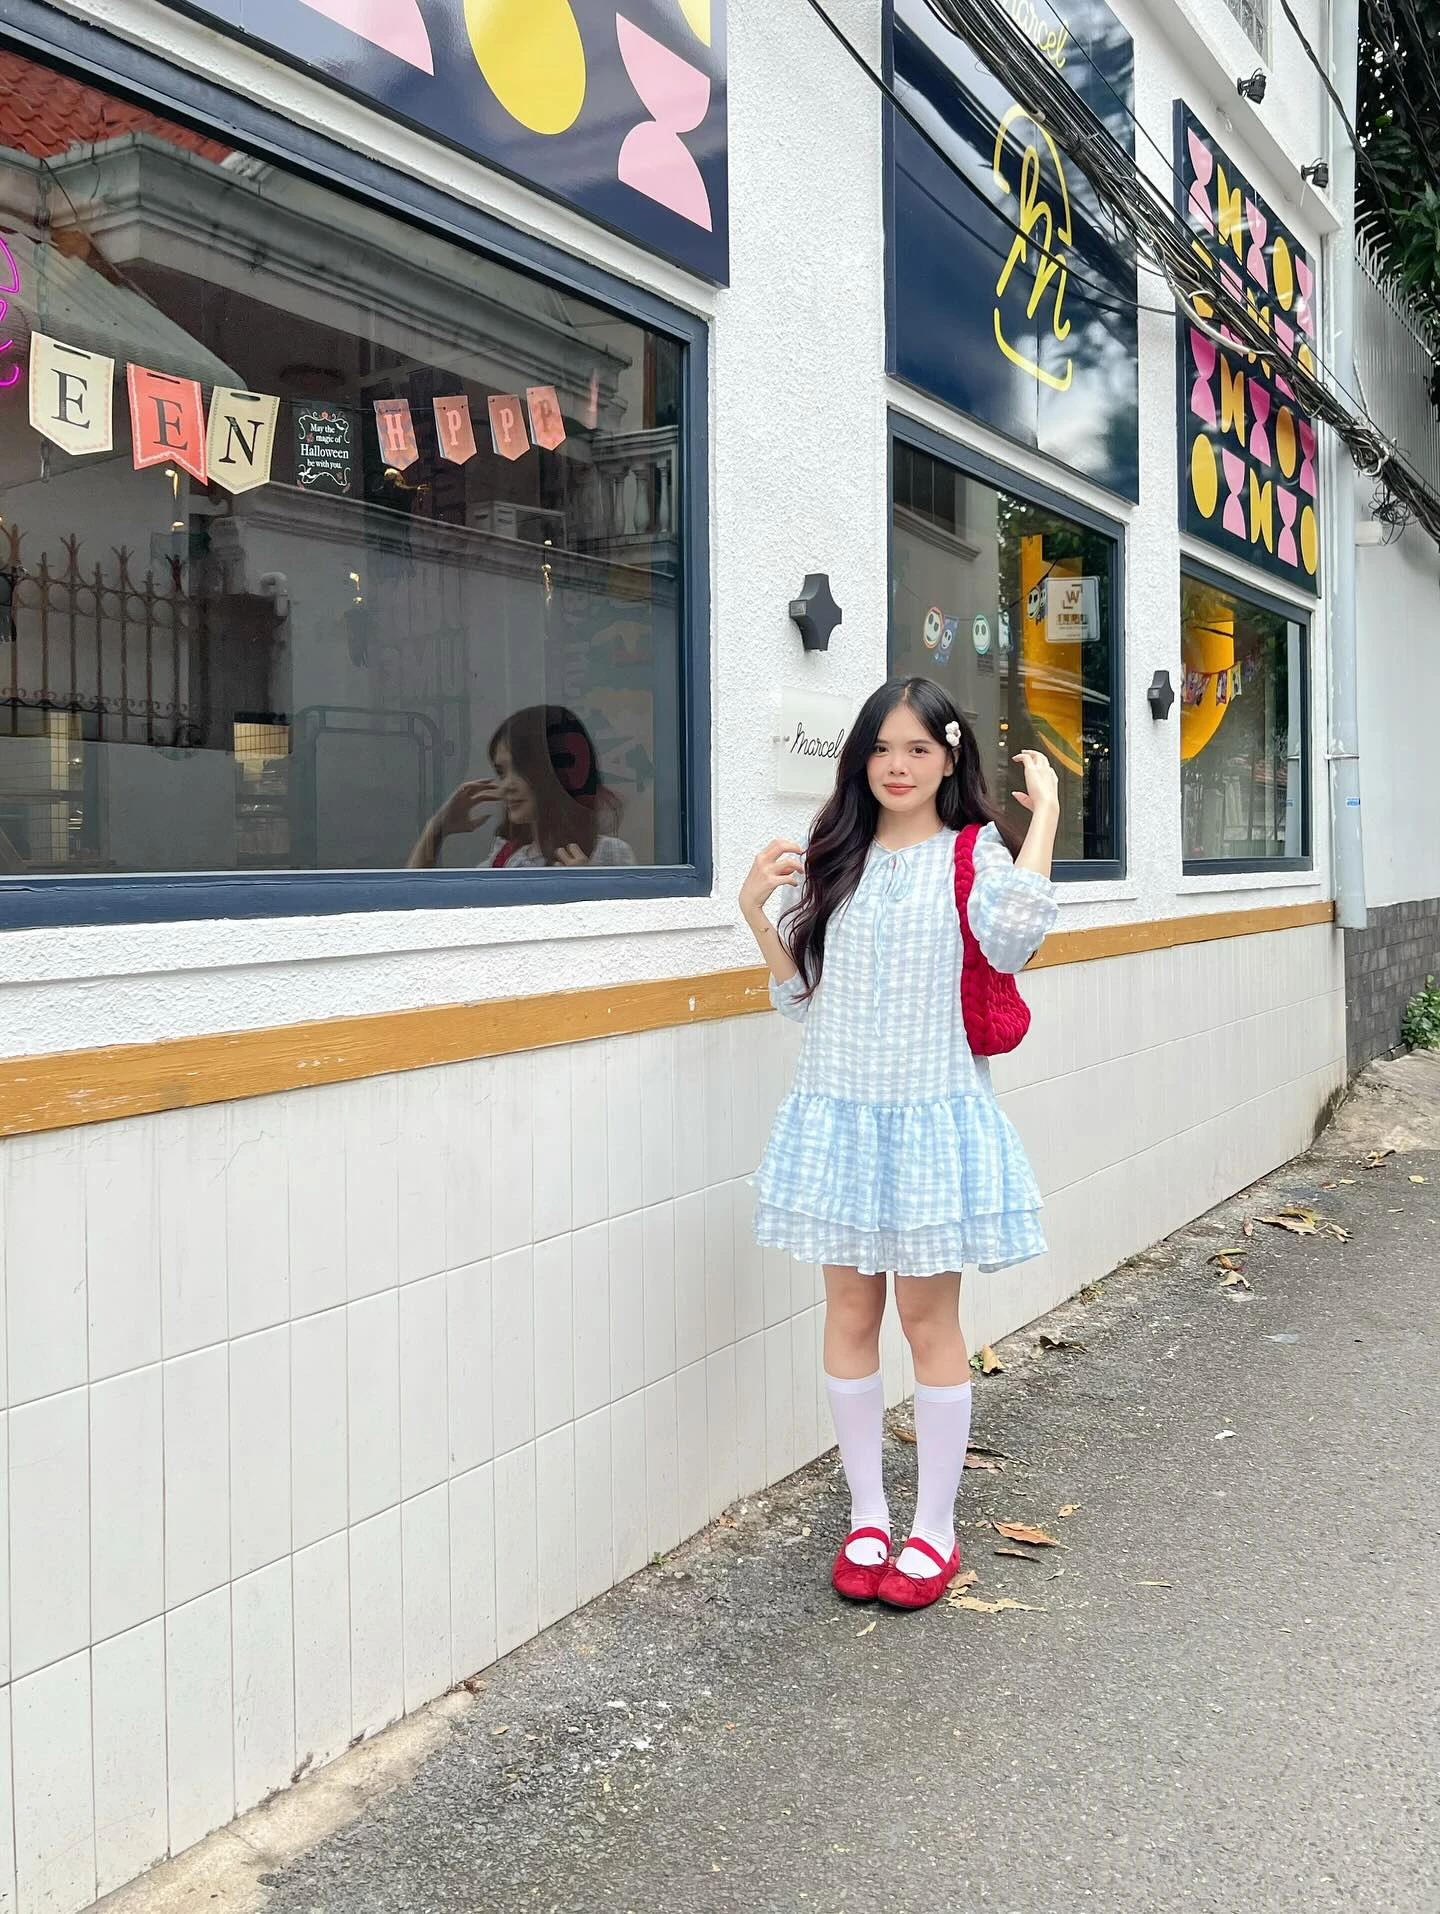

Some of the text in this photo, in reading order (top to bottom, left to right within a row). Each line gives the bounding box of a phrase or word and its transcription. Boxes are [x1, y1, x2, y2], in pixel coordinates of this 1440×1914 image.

[1000, 0, 1070, 69] arcel
[310, 423, 335, 434] May the
[316, 434, 342, 444] magic of
[300, 443, 349, 459] Halloween
[307, 459, 315, 467] be
[316, 460, 330, 469] with
